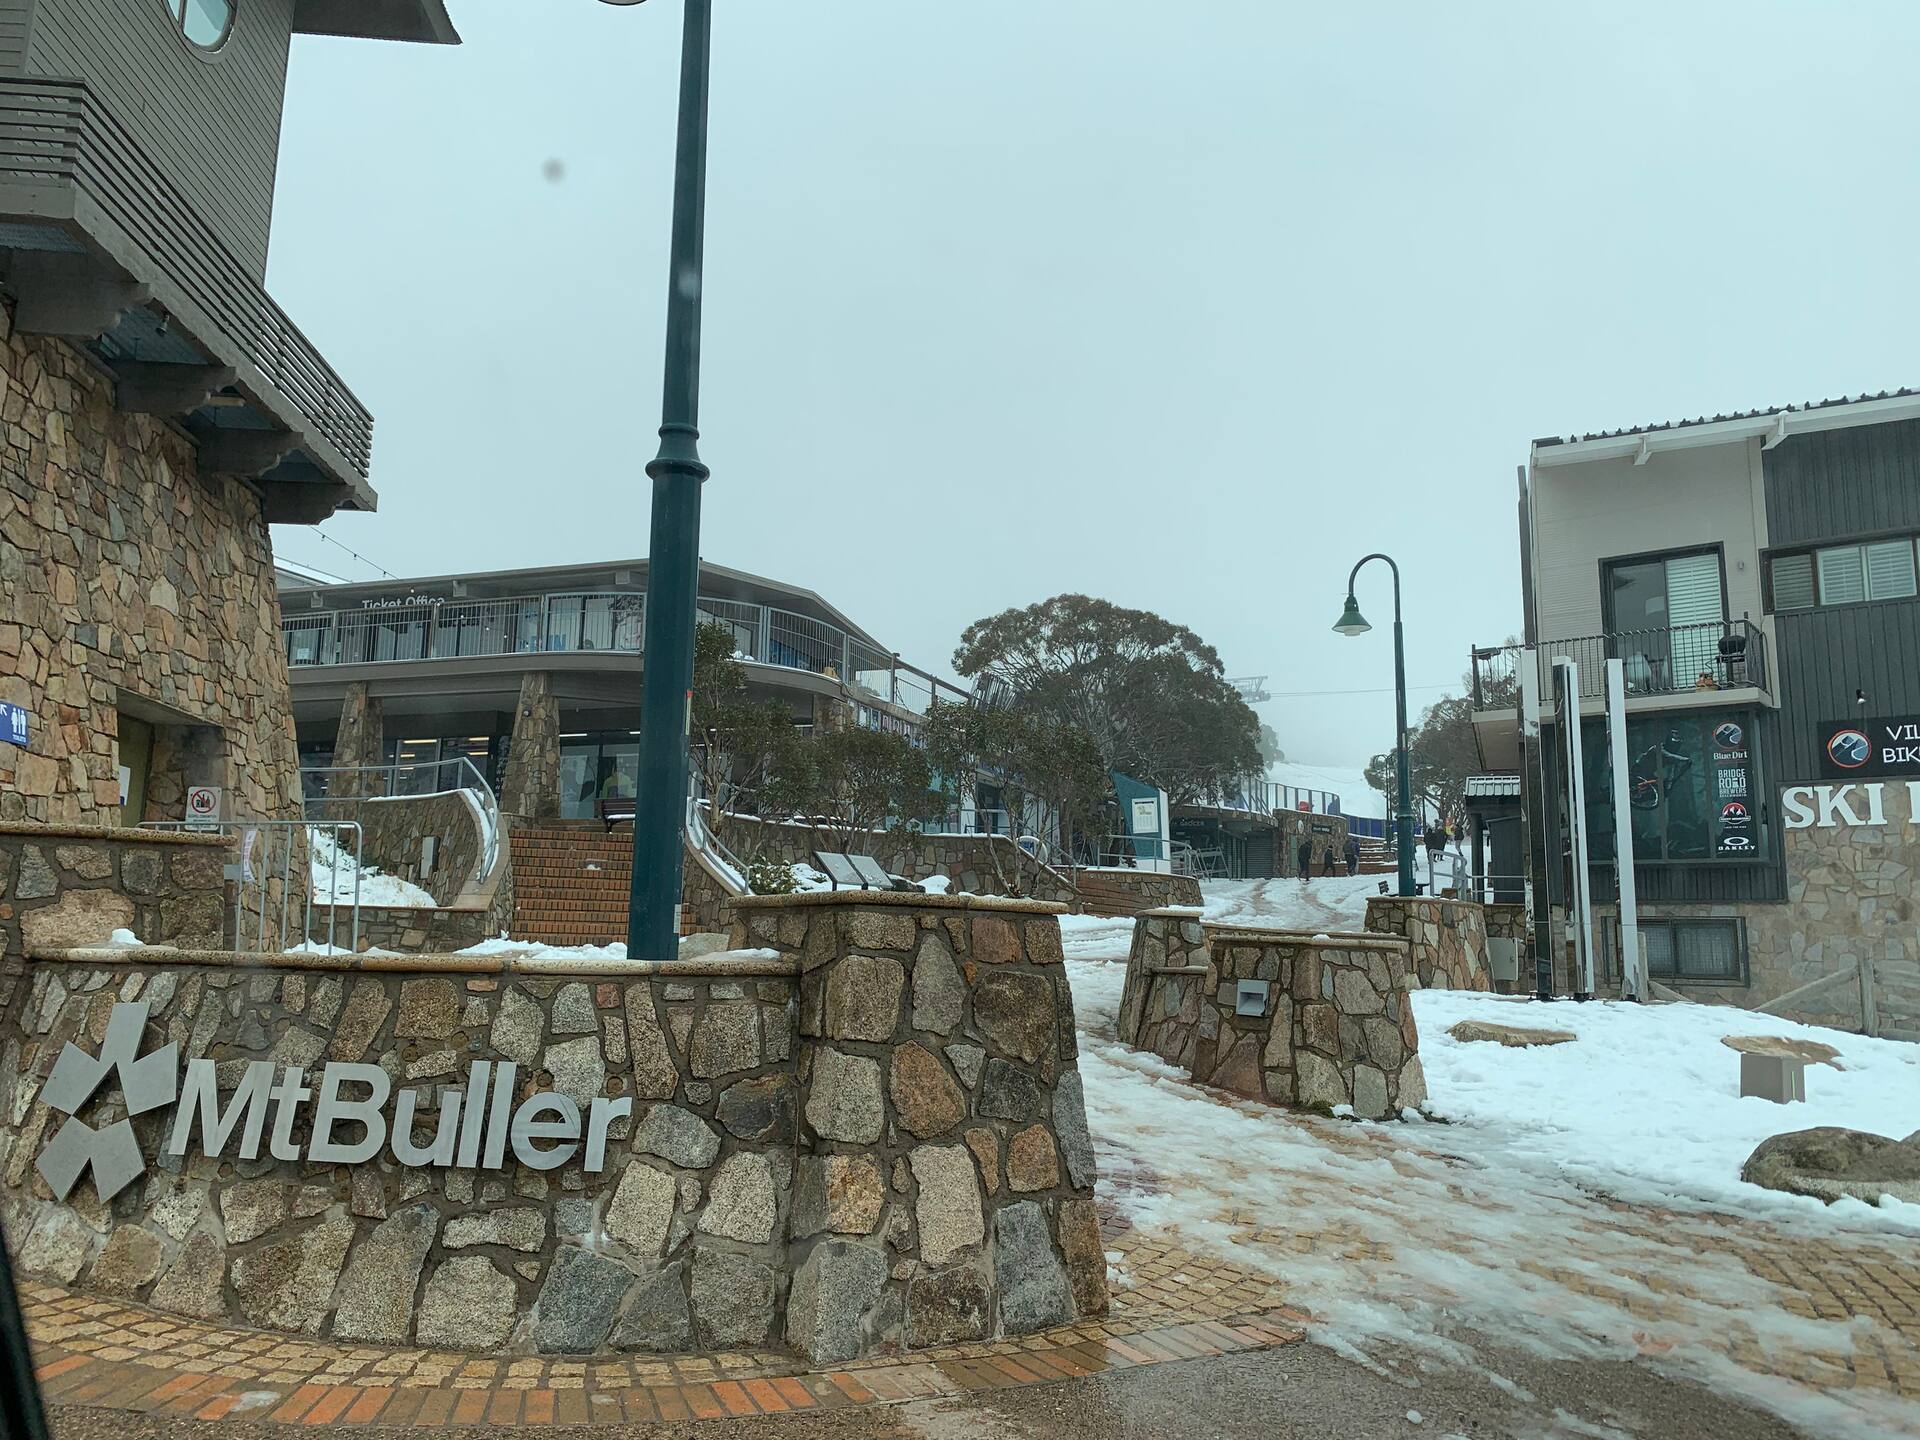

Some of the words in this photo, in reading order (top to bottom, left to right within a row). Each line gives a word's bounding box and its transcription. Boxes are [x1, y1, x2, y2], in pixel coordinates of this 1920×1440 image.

[362, 598, 402, 609] Ticket
[1713, 752, 1731, 760] Blue
[1732, 751, 1748, 759] Dirt
[1882, 746, 1920, 763] BIK
[1718, 768, 1746, 777] BRIDGE
[1719, 787, 1747, 795] BREWERS
[1782, 783, 1888, 829] SKI
